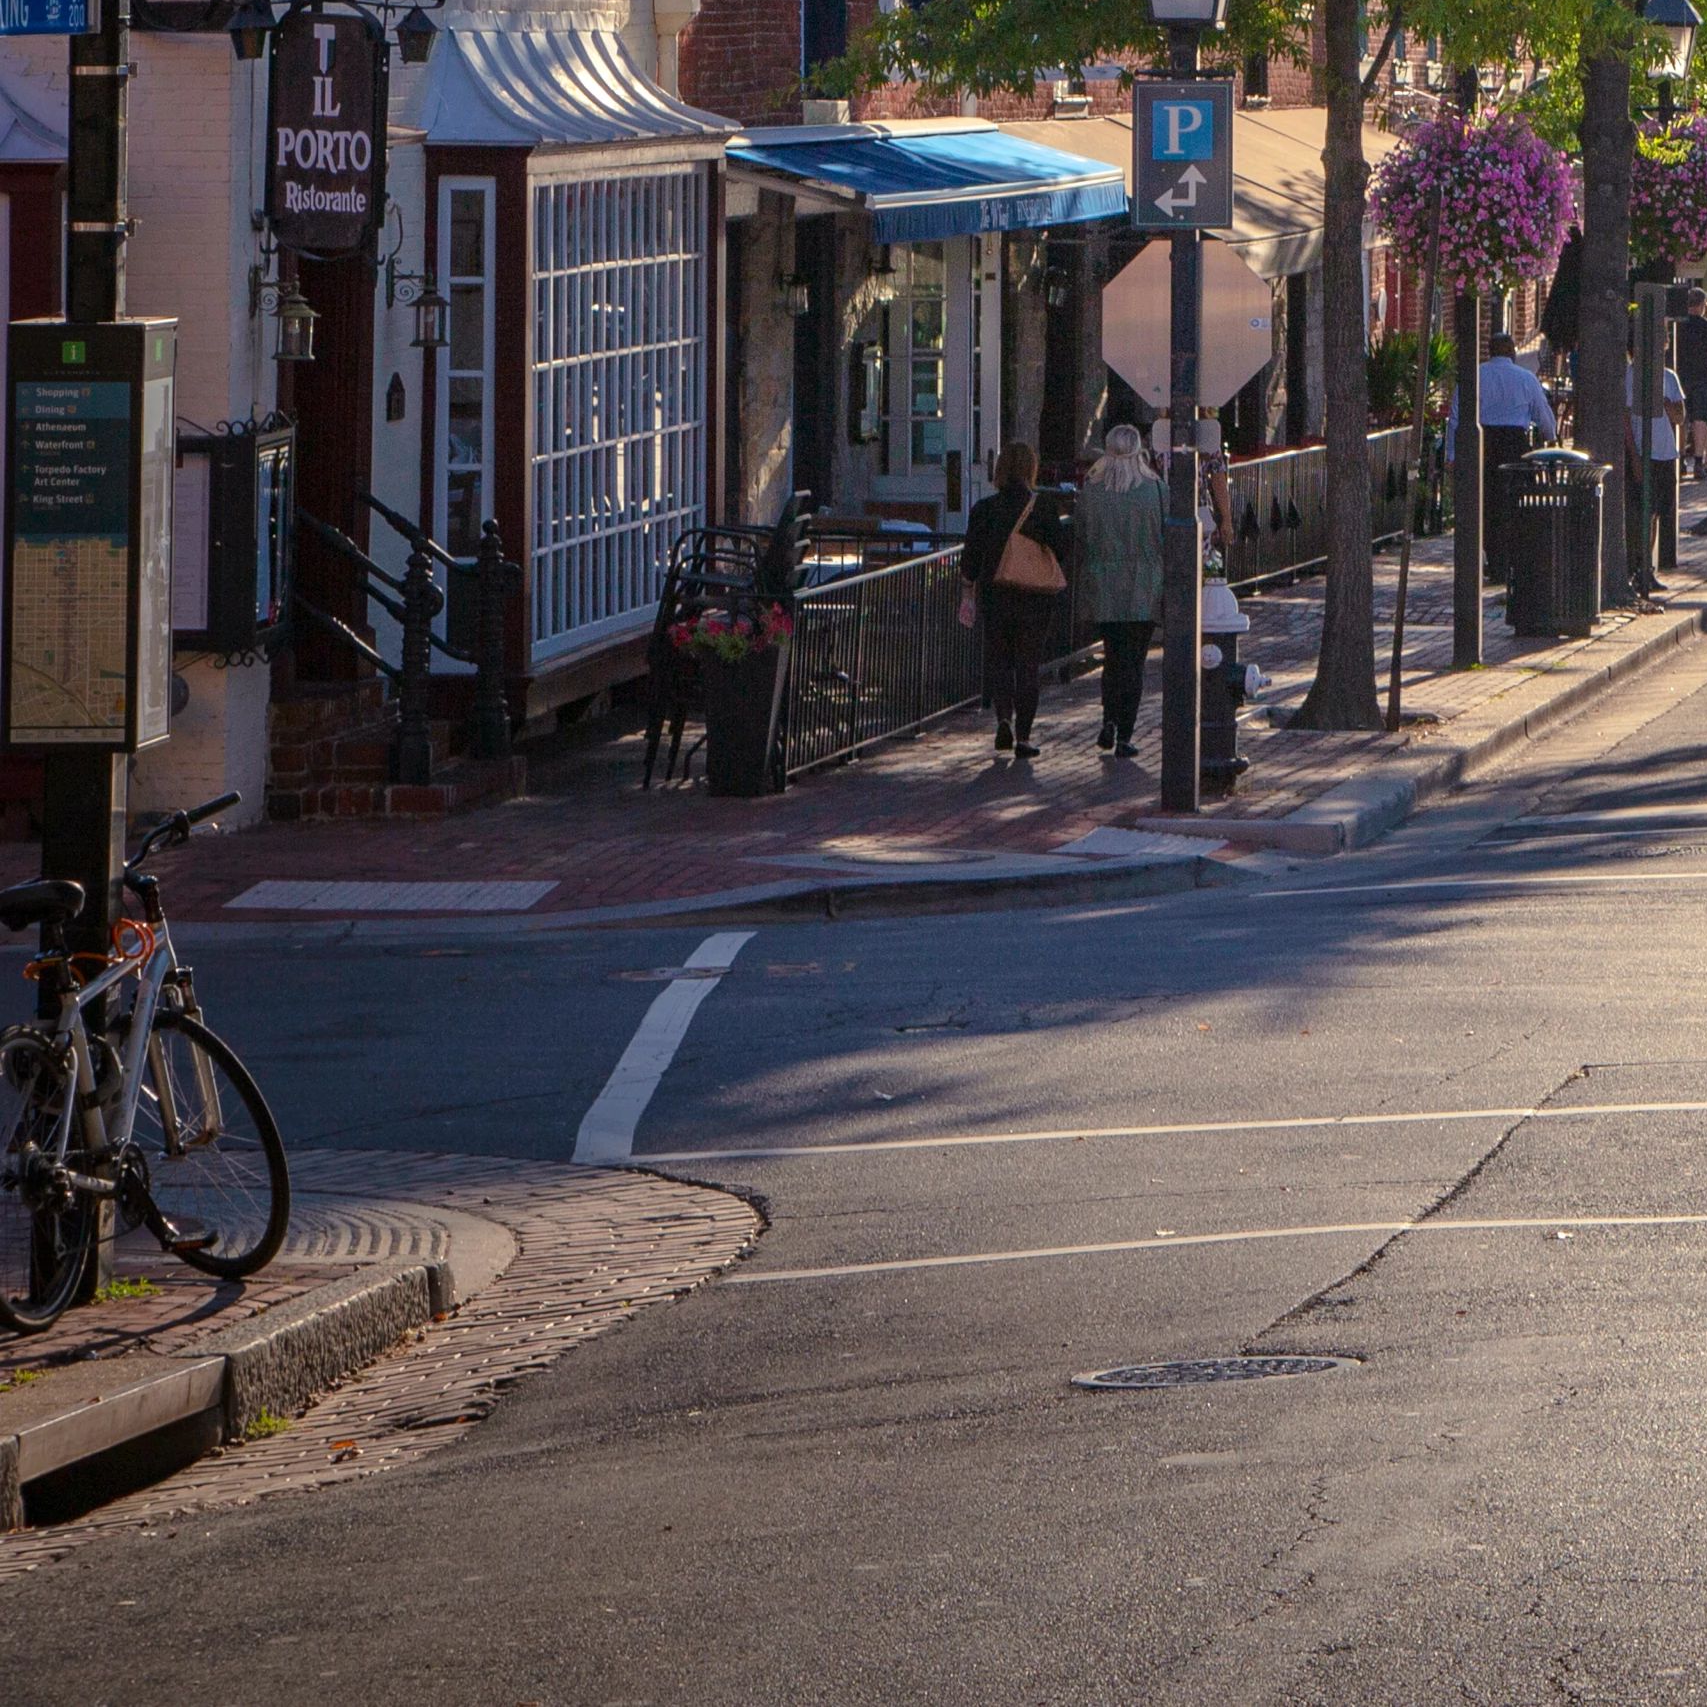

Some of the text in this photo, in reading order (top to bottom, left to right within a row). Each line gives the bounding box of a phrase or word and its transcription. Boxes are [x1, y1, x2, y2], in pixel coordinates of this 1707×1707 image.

[68, 4, 85, 27] 200
[312, 76, 341, 117] IL
[1163, 105, 1202, 155] P
[276, 127, 372, 175] PORTO
[284, 180, 367, 214] Ristorante
[36, 387, 79, 399] Shopping
[35, 405, 65, 415] Dining
[35, 422, 87, 432] Athenaeum
[35, 440, 84, 450] Waterfront
[35, 465, 107, 476] Torpedo Factory
[34, 477, 80, 486] Art Center
[33, 495, 83, 505] King Street
